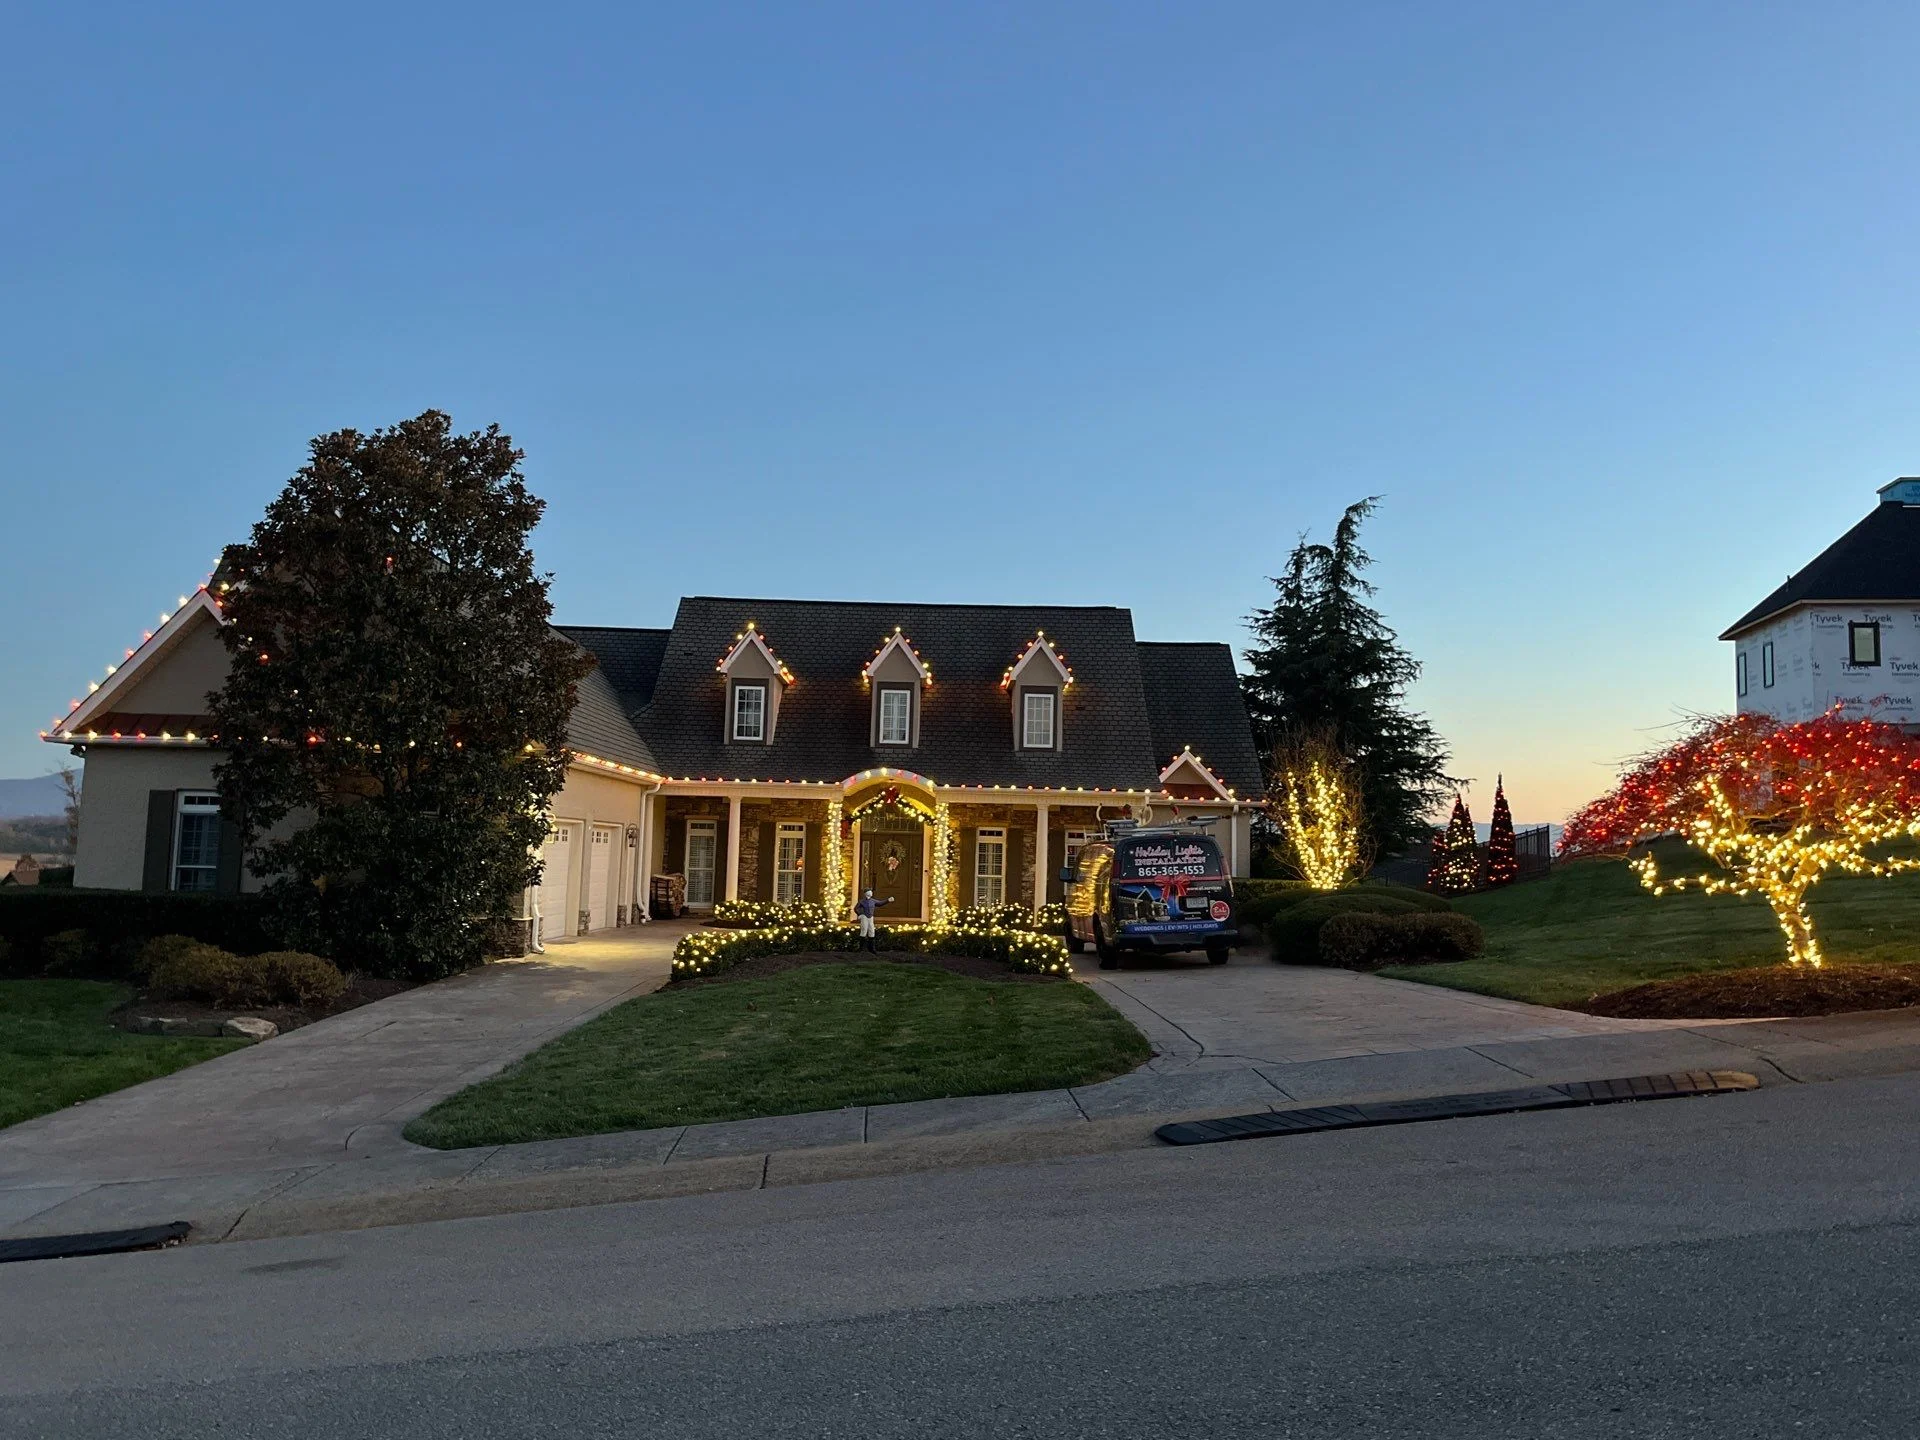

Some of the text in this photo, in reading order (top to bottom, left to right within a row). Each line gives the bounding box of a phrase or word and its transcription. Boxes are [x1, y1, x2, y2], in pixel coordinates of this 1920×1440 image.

[1814, 614, 1843, 624] Tyvek
[1864, 614, 1892, 623] Tyvek
[1889, 662, 1919, 671] Tyvek
[1834, 696, 1863, 705] Tyvek
[1885, 696, 1912, 705] Tyvek
[1135, 844, 1204, 858] Holiday Lights
[1134, 856, 1206, 866] INSTALLATION
[1138, 865, 1205, 877] 865-365-1553
